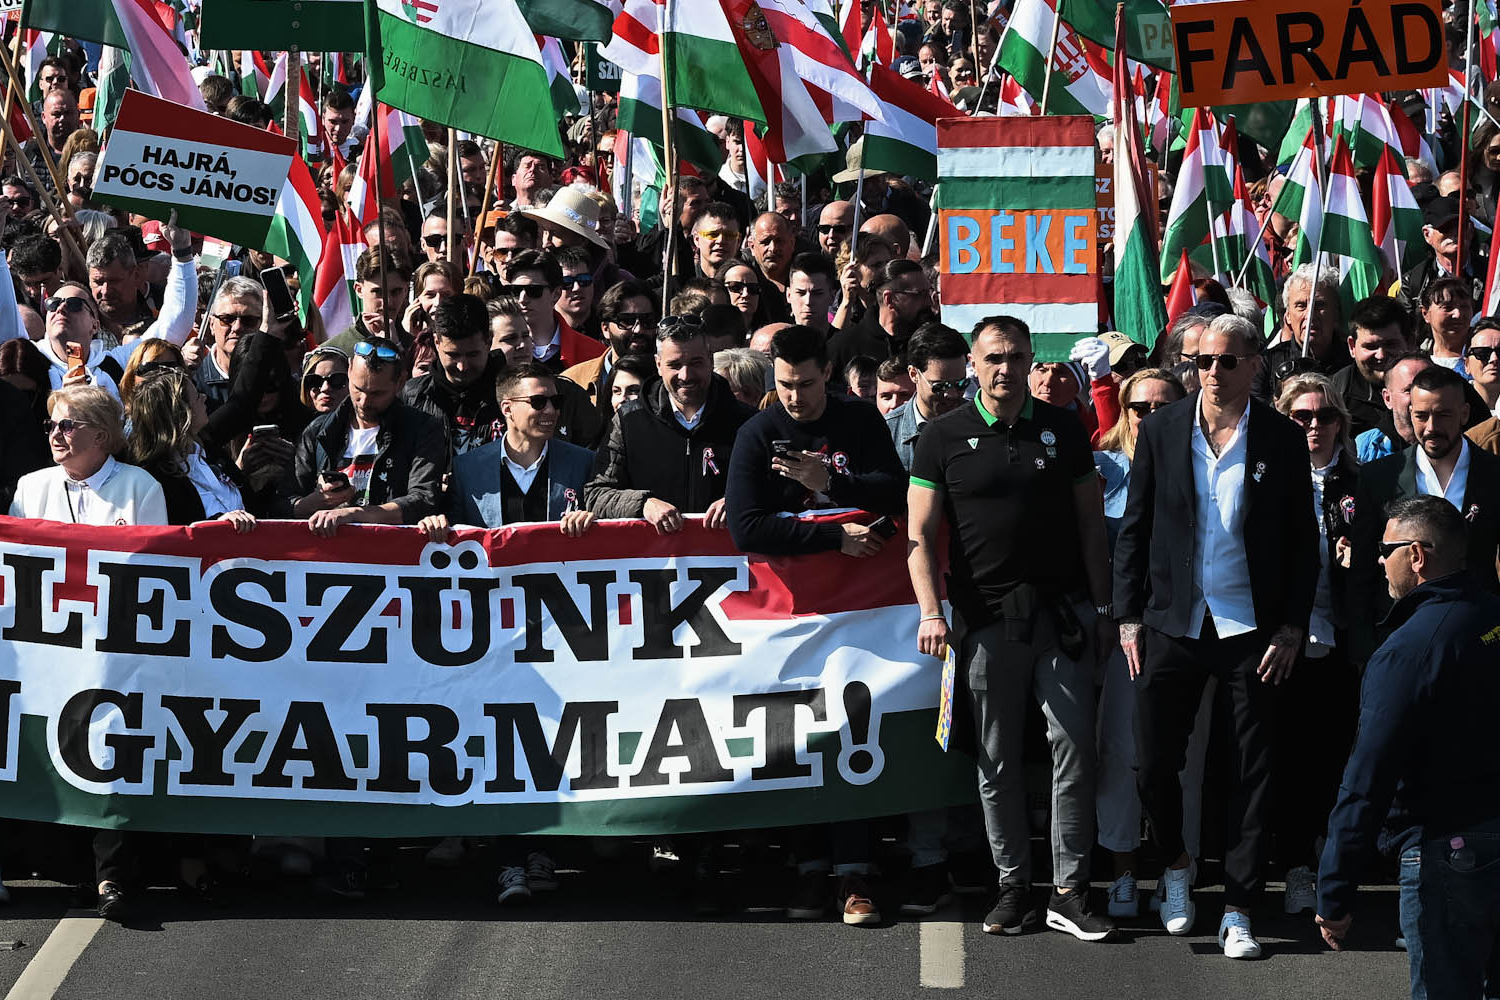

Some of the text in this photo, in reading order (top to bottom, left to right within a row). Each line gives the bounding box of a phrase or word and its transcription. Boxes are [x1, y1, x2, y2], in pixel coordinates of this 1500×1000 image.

[102, 163, 278, 207] PÓCS JÁNOS!
[142, 145, 238, 180] HAJRÁ,
[947, 208, 1088, 275] BÉKE
[3, 547, 748, 668] LESZÜNK
[57, 679, 878, 795] GYARMAT!
